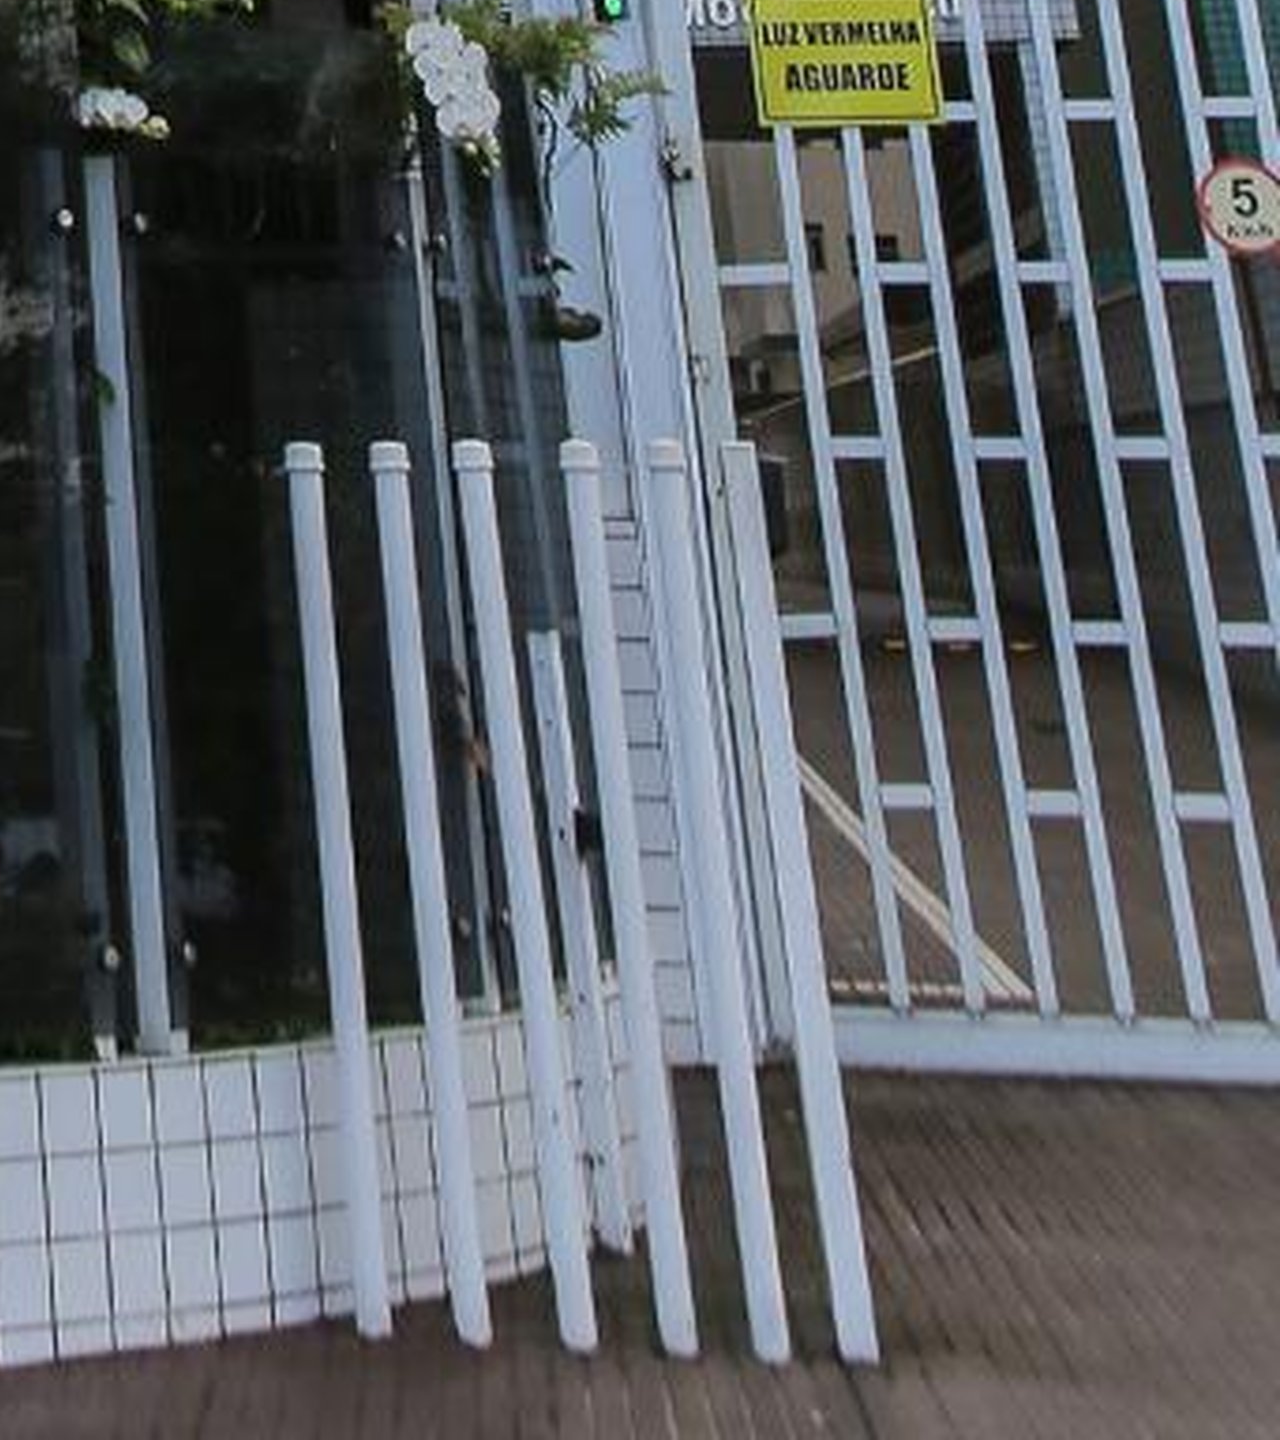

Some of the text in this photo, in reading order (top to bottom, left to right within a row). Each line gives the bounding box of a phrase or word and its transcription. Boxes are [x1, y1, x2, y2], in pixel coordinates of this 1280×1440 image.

[761, 20, 921, 46] LUZ VERMELHA
[785, 62, 911, 92] AGUARDE
[1232, 178, 1259, 218] 5
